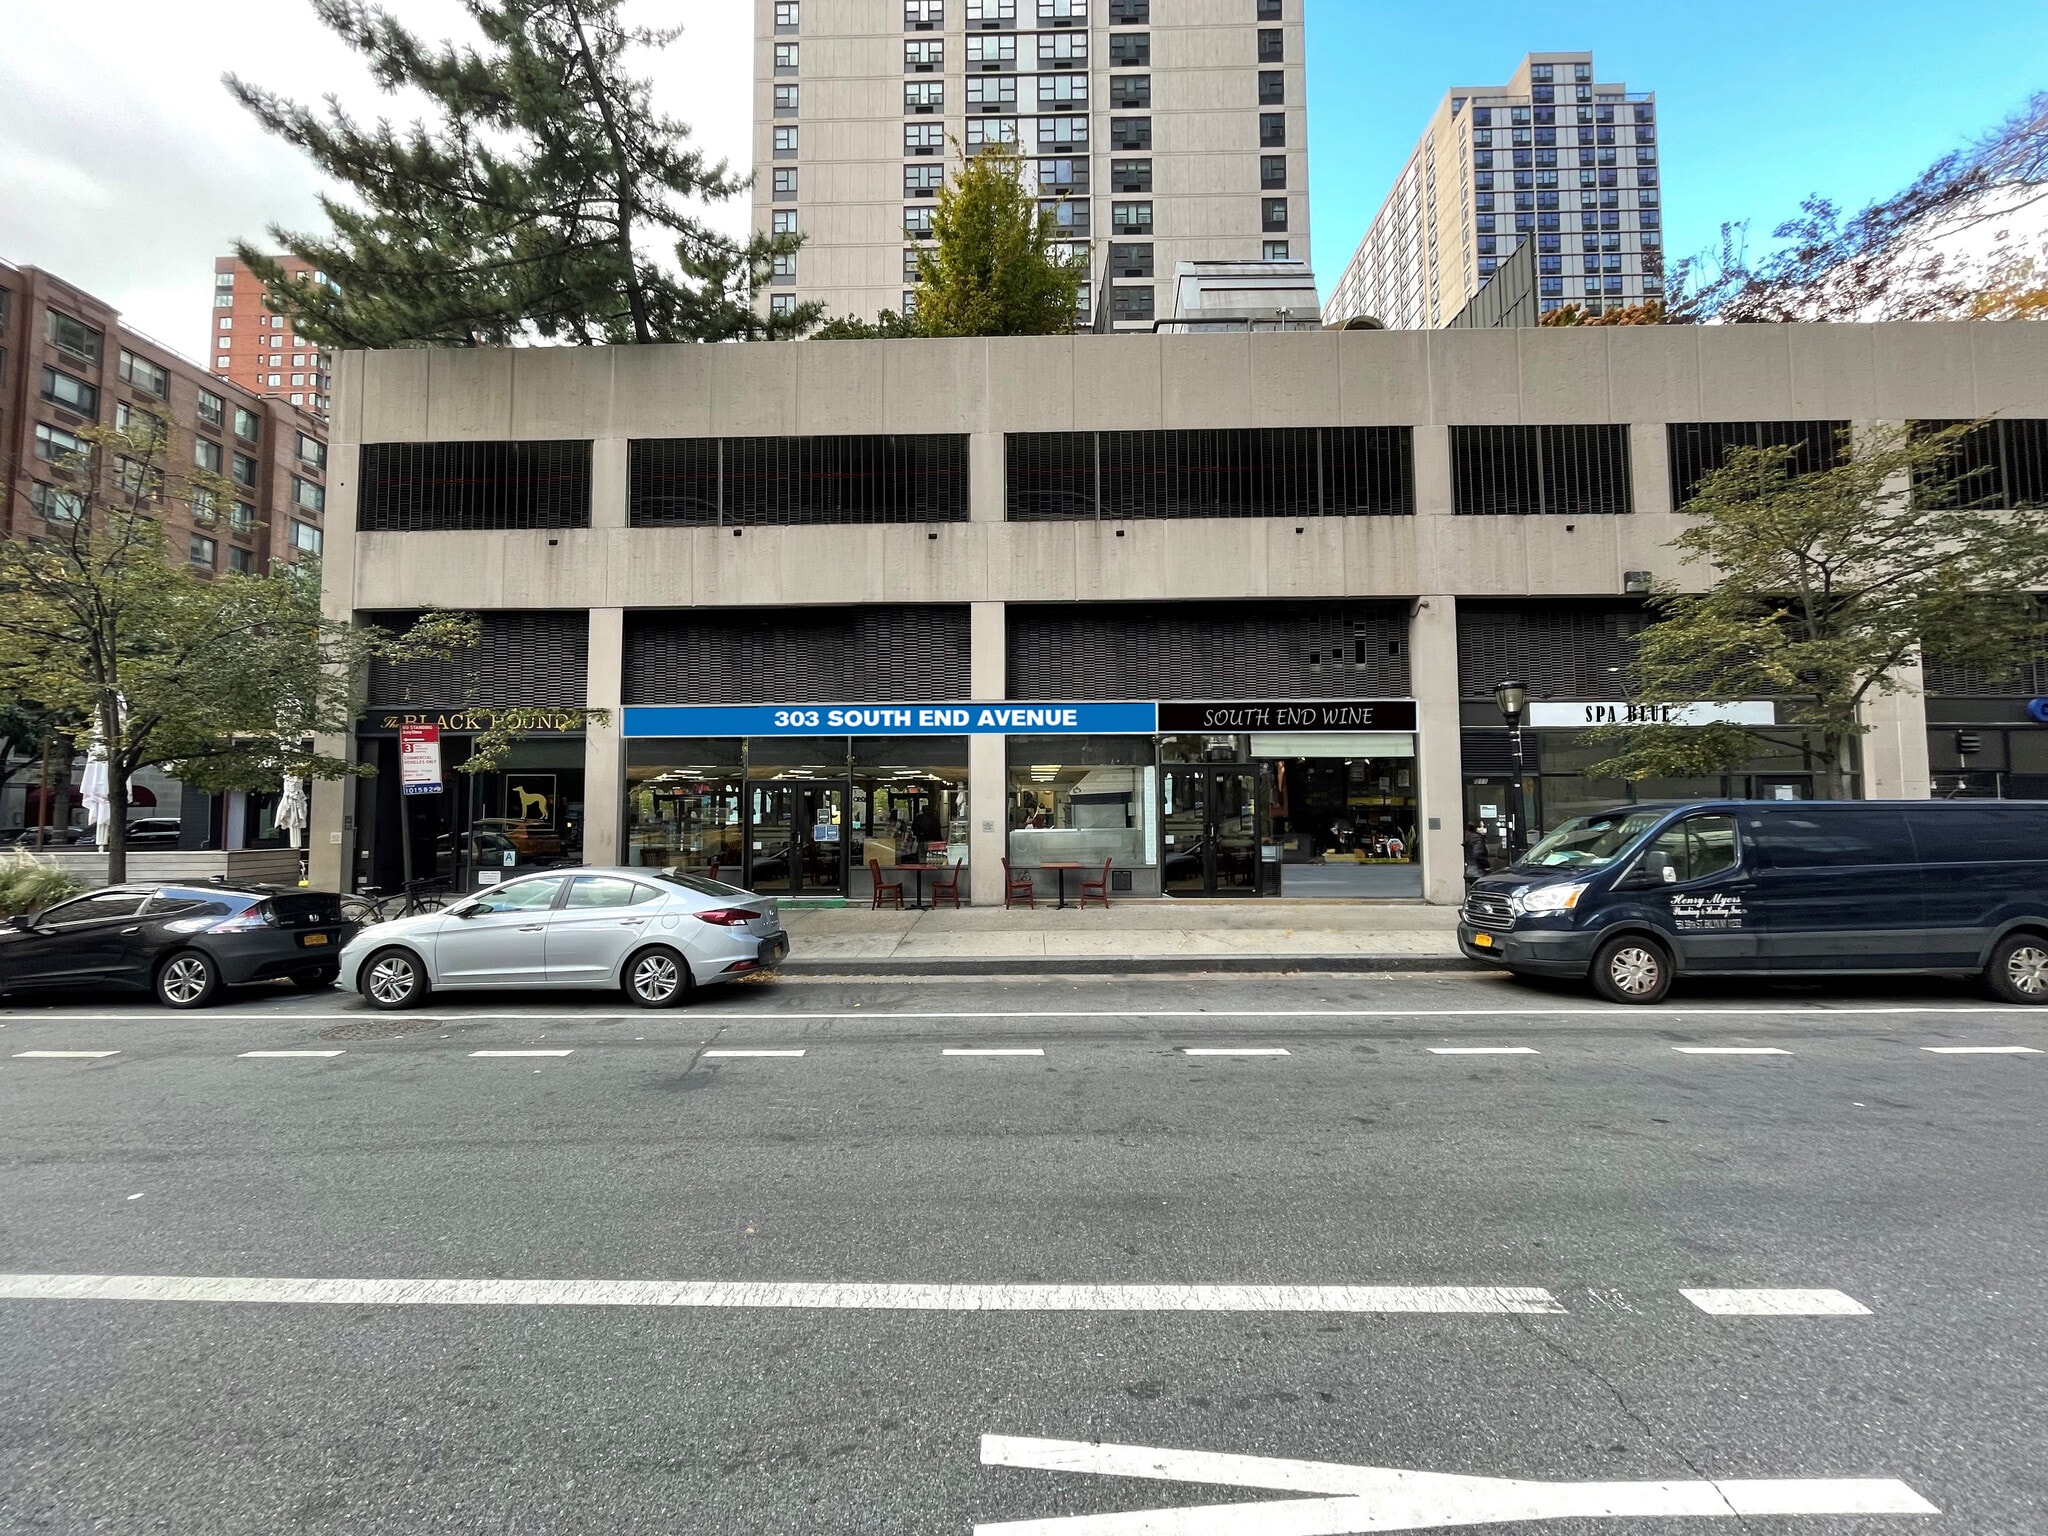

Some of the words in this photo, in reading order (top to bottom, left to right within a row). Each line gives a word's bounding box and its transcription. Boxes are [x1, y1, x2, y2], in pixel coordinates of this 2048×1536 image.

[774, 710, 820, 727] 303
[827, 710, 911, 727] SOUTH
[918, 710, 970, 727] END
[977, 709, 1078, 726] AVENUE
[1203, 709, 1271, 726] SOUTH
[1276, 708, 1317, 725] END
[1321, 707, 1374, 725] WINE
[1586, 706, 1616, 722] SPA
[1626, 705, 1670, 723] BLUE
[380, 716, 400, 728] The
[405, 744, 412, 752] 3
[505, 852, 513, 862] A
[1670, 894, 1704, 907] Henry
[1707, 893, 1741, 906] Myers
